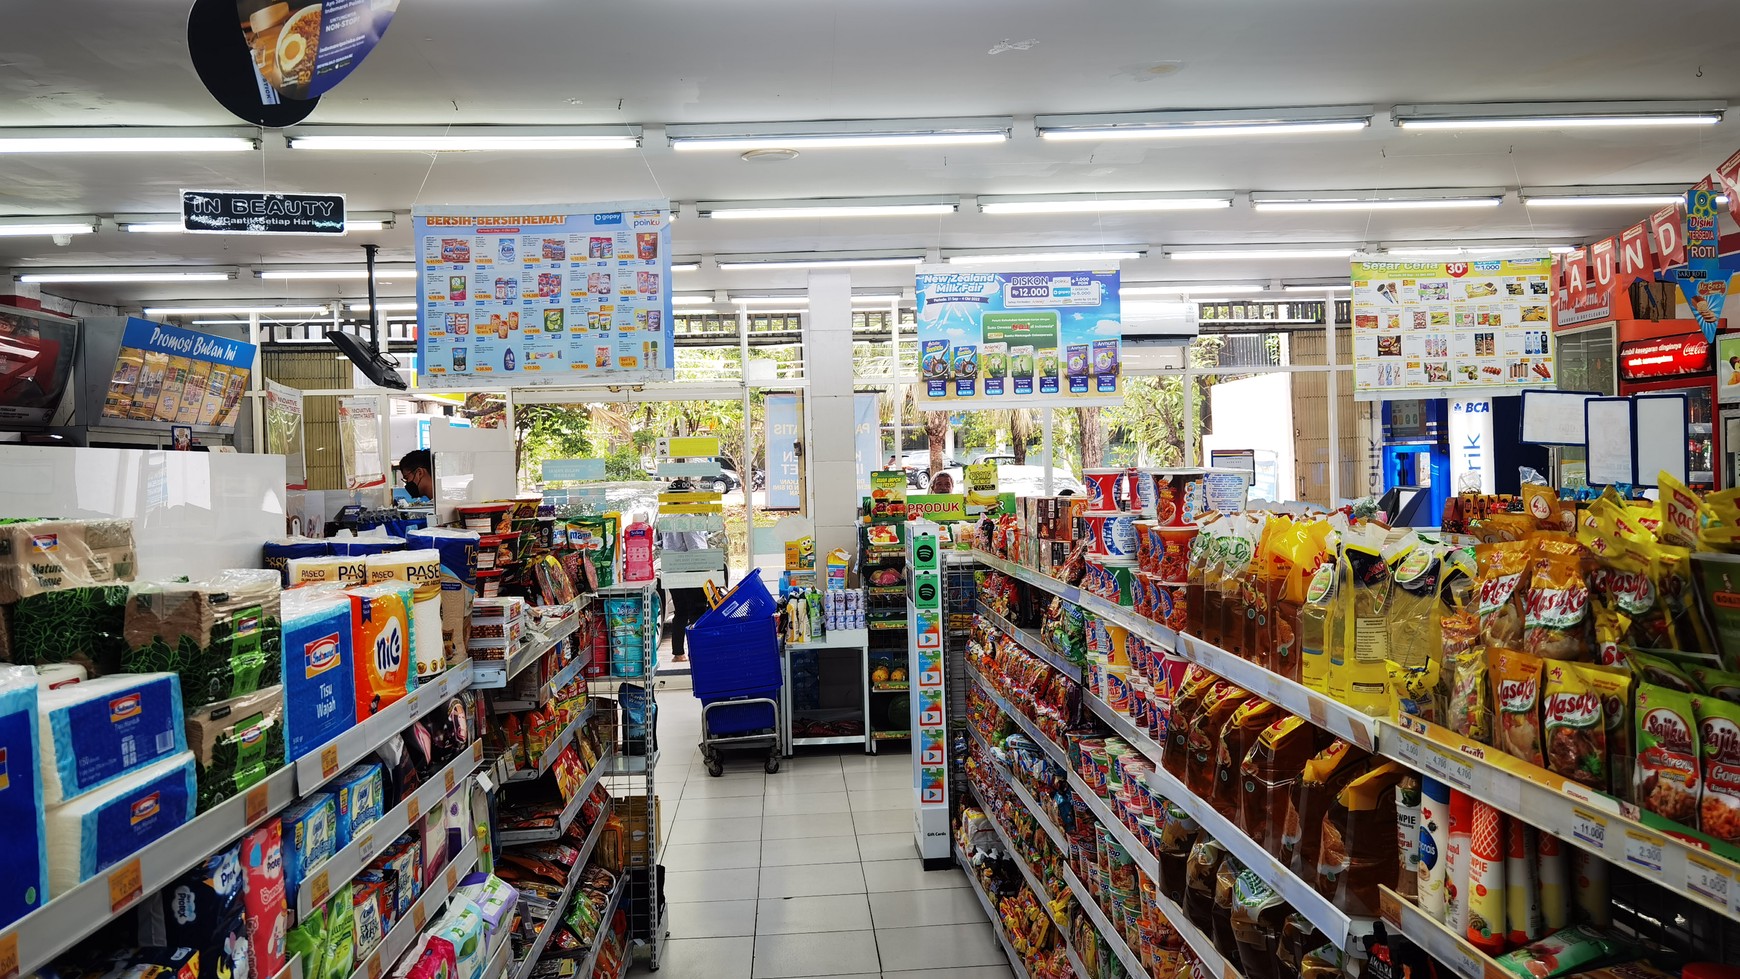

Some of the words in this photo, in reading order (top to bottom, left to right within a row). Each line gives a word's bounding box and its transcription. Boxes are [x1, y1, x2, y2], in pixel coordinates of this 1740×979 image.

[193, 198, 221, 214] IN
[231, 199, 335, 216] BEAUTY
[522, 214, 566, 226] HEMAT
[601, 213, 621, 222] gopay
[633, 218, 661, 229] poinku
[1690, 216, 1714, 228] Disini
[1689, 230, 1714, 240] TERSEDIA
[1691, 246, 1716, 258] ROTI
[1362, 262, 1400, 273] Segar
[923, 275, 948, 283] New
[950, 273, 995, 283] Zealand
[1011, 276, 1049, 286] DISKON
[936, 284, 958, 293] Milk
[961, 284, 983, 293] Fair
[1019, 288, 1048, 297] 12.000
[149, 327, 195, 353] Promosi
[193, 336, 224, 359] Bulan
[223, 344, 238, 361] Ini
[1465, 402, 1490, 413] BCA
[908, 502, 960, 513] PRODUK
[464, 544, 478, 566] Te
[301, 570, 325, 578] PASEO
[338, 563, 367, 581] PAS
[371, 570, 395, 579] PASEO
[406, 562, 441, 581] PASE
[1525, 584, 1589, 621] Masako
[319, 683, 333, 699] Tisu
[316, 696, 336, 719] Wajah
[1544, 690, 1599, 721] Masako
[1648, 714, 1687, 743] Sajiku
[1702, 722, 1740, 755] Sajik
[1712, 765, 1740, 781] Gore
[1580, 823, 1604, 841] 11.000
[267, 857, 281, 872] Prote
